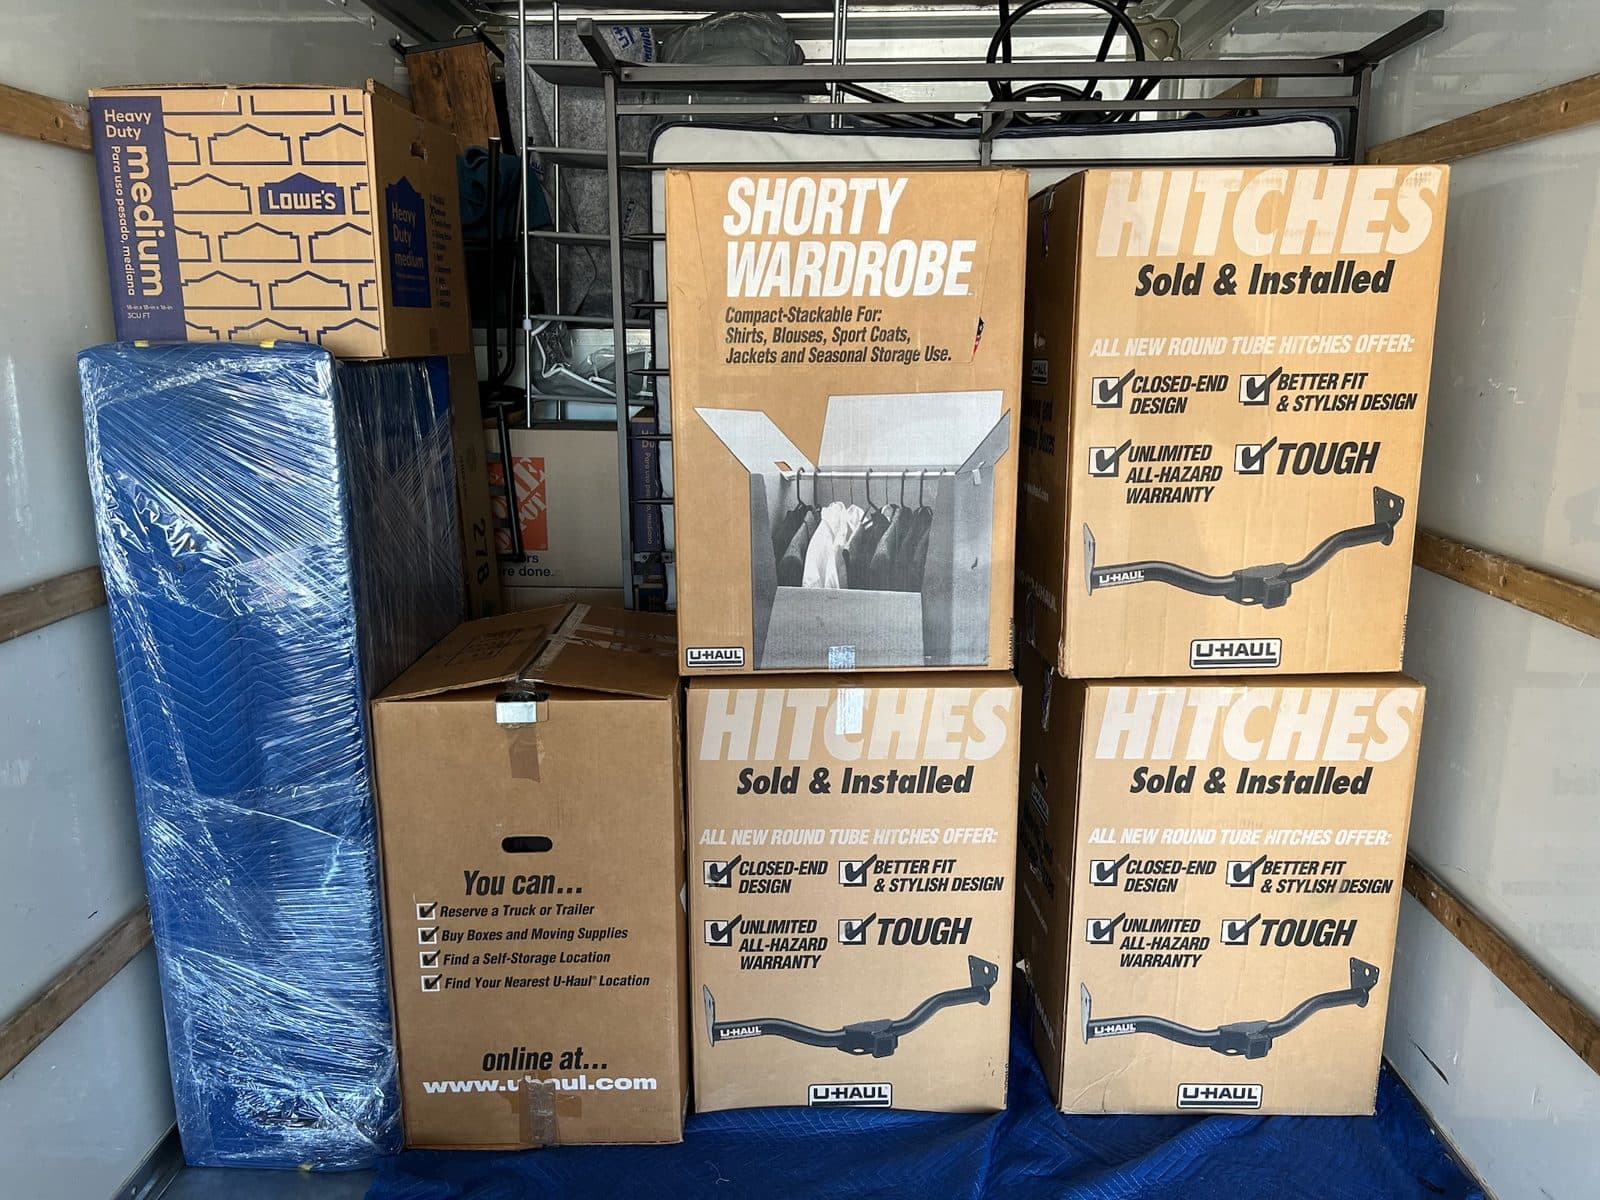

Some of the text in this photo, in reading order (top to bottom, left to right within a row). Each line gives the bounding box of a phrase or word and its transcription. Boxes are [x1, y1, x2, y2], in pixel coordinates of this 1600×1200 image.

[104, 109, 152, 126] Heavy
[105, 125, 142, 141] Duty
[267, 190, 337, 211] LOWE'S
[722, 177, 908, 236] SHORTY
[111, 146, 136, 296] Para uso pesado, mediana
[126, 145, 165, 297] medium
[391, 200, 416, 229] Heavy
[1096, 167, 1442, 257] HITCHES
[392, 223, 412, 247] Duty
[394, 251, 424, 270] medium
[726, 239, 977, 298] WARDROBE
[1134, 260, 1396, 296] Sold & Installed
[725, 306, 882, 326] Compact-Stackable For:
[725, 326, 911, 346] Shirts, Blouses, Sport Coats,
[1090, 334, 1415, 358] ALL NEW ROUND TUBE HITCHES OFFER:
[725, 346, 952, 365] Jackets and Seasonal Storage Use.
[1131, 374, 1229, 394] CLOSED-END
[1277, 372, 1369, 391] BETTER FIT
[1129, 396, 1187, 415] DESIGN
[1276, 393, 1418, 412] & STYLISH DESIGN
[1127, 444, 1213, 463] UNLIMITED
[1276, 441, 1382, 476] TOUGH
[1126, 465, 1223, 483] ALL-HAZARD
[1126, 486, 1215, 505] WARRANTY
[518, 566, 554, 577] done.
[1098, 570, 1145, 584] U-HAUL
[690, 650, 742, 660] U-HAUL
[1195, 643, 1277, 658] U-HAUL
[700, 688, 1013, 761] HITCHES
[1095, 687, 1418, 762] HITCHES
[737, 765, 975, 794] Sold & Installed
[1130, 766, 1373, 795] Sold & Installed
[700, 827, 999, 845] ALL NEW ROUND TUBE HITCHES OFFER:
[1088, 827, 1393, 846] ALL NEW ROUND TUBE HITCHES OFFER:
[739, 860, 828, 875] CLOSED-END
[873, 859, 957, 874] BETTER FIT
[1125, 860, 1217, 875] CLOSED-END
[1261, 860, 1346, 875] BETTER FIT
[463, 870, 583, 896] You can...
[738, 879, 792, 894] DESIGN
[873, 877, 1004, 893] & STYLISH DESIGN
[1124, 878, 1178, 893] DESIGN
[1261, 879, 1393, 895] & STYLISH DESIGN
[440, 904, 595, 918] Reserve a Truck or Trailer
[740, 920, 817, 935] UNLIMITED
[877, 917, 972, 946] TOUGH
[1121, 918, 1201, 933] UNLIMITED
[1259, 919, 1358, 947] TOUGH
[441, 927, 628, 943] Buy Boxes and Moving Supplies
[1120, 936, 1210, 951] ALL-HAZARD
[739, 937, 828, 952] ALL-HAZARD
[443, 952, 611, 966] Find a Self-Storage Location
[740, 955, 822, 970] WARRANTY
[1119, 954, 1203, 968] WARRANTY
[444, 977, 470, 989] Find
[474, 976, 501, 988] Your
[504, 976, 550, 988] Nearest
[598, 974, 650, 987] Location
[720, 1026, 762, 1038] U-HAUL
[1094, 1022, 1137, 1035] U-HAUL
[482, 1047, 608, 1072] online at...
[813, 1086, 889, 1100] U-HAUL
[1183, 1088, 1260, 1100] U-HAUL
